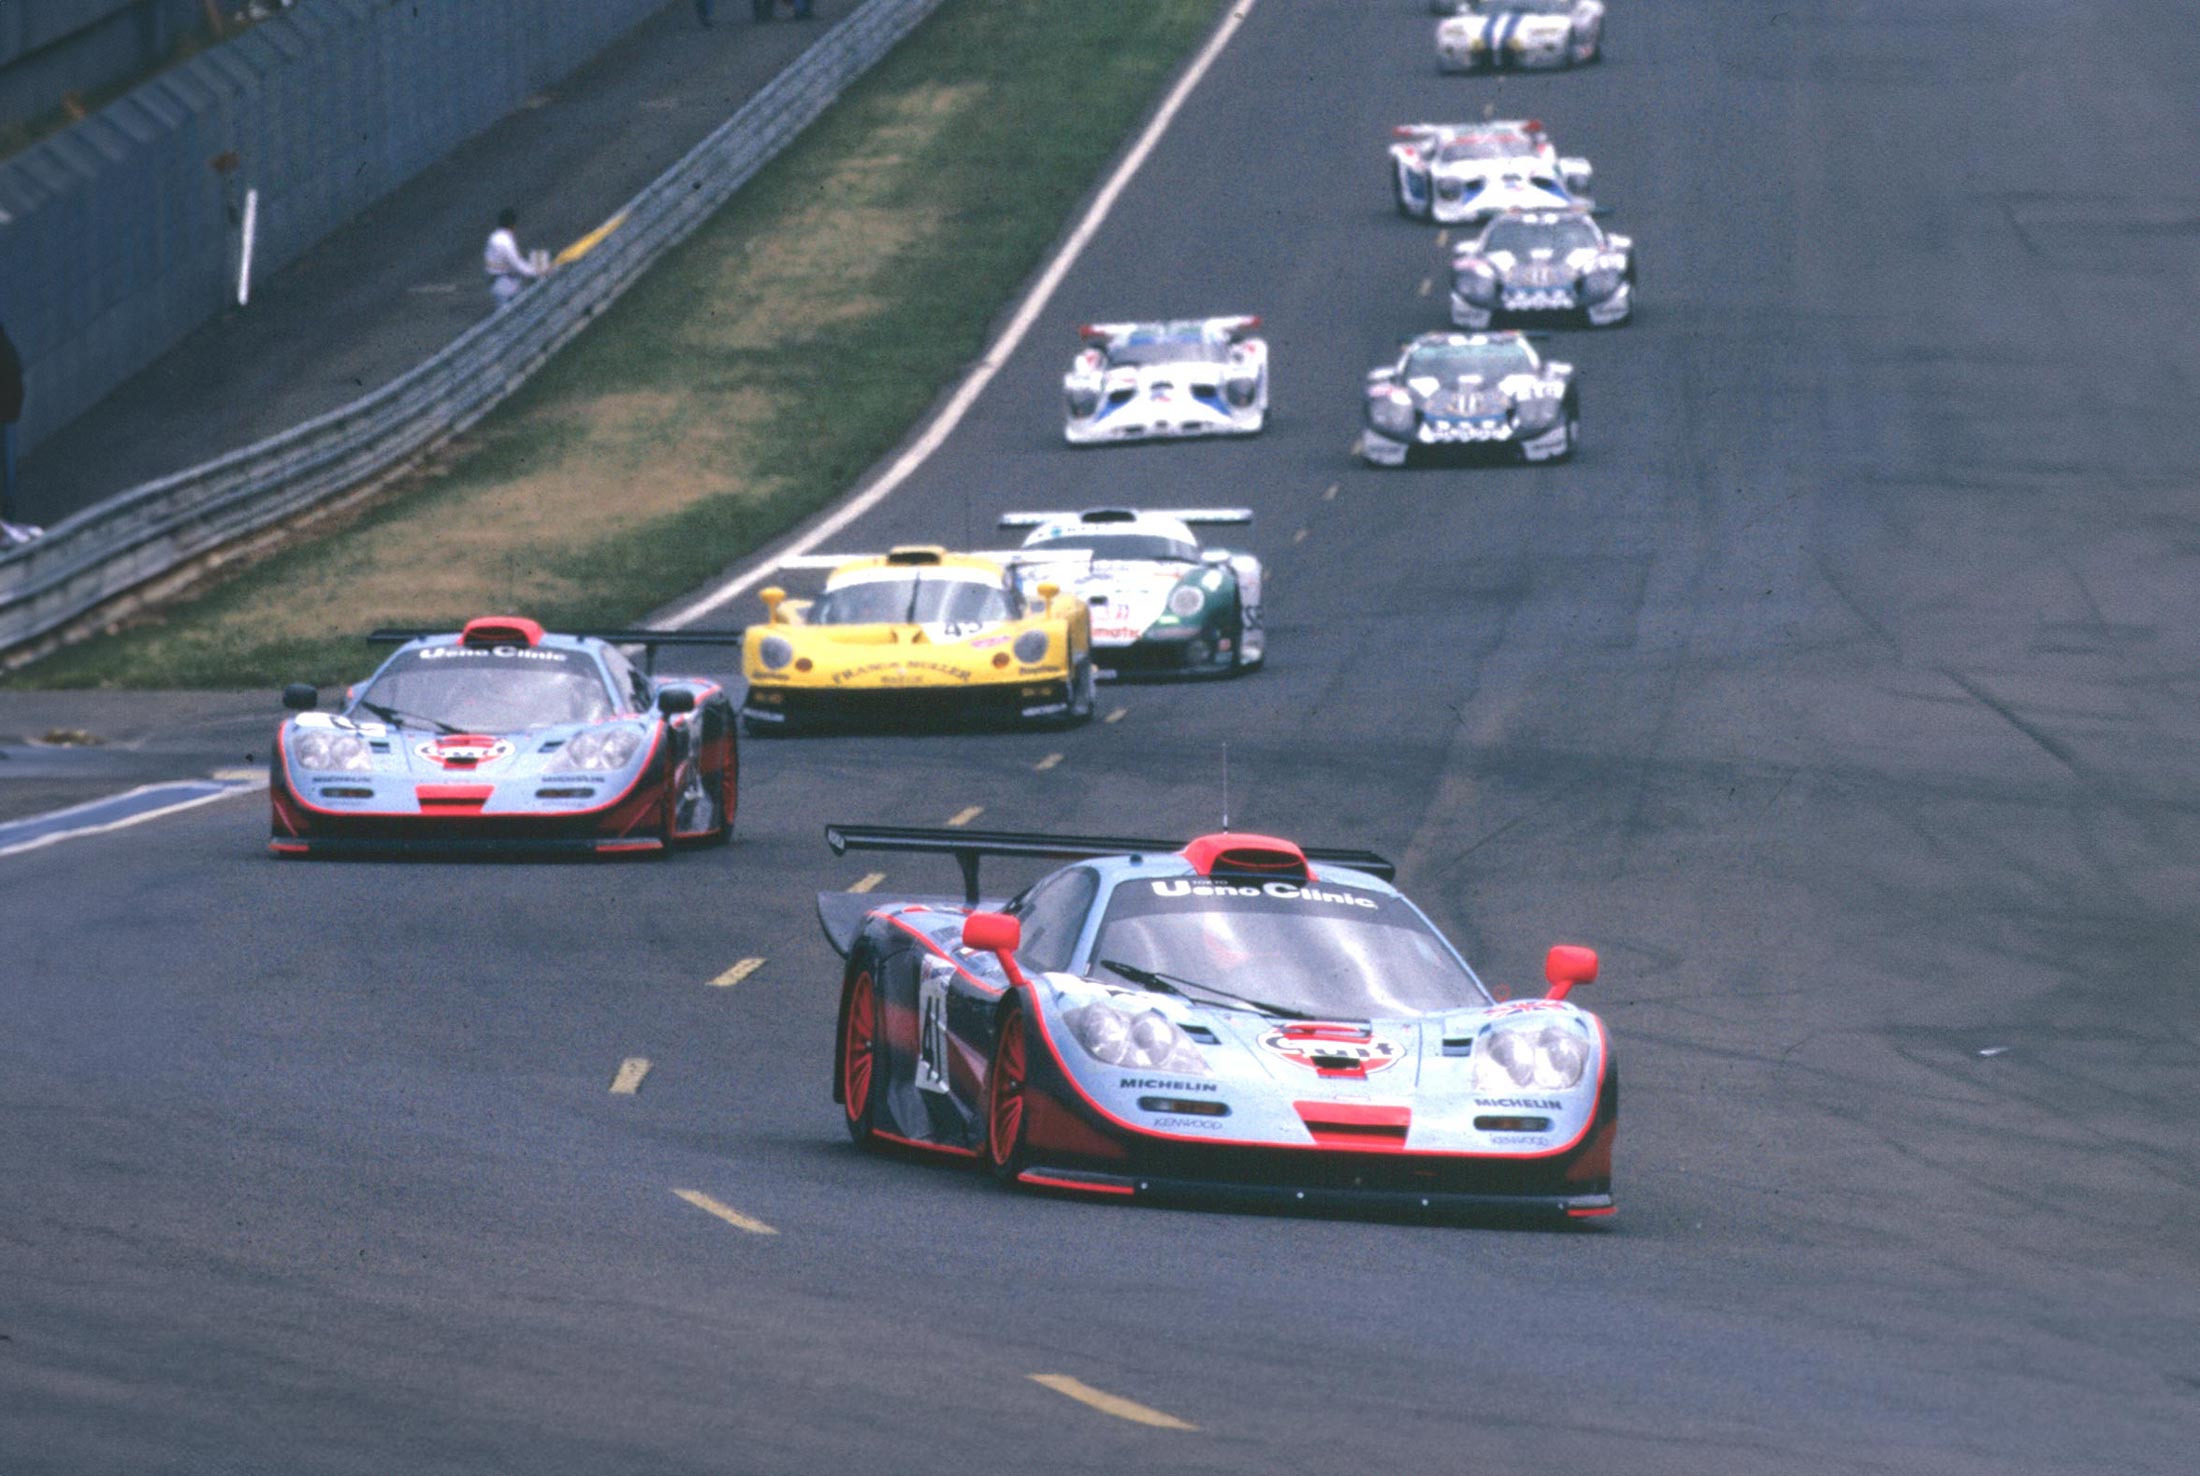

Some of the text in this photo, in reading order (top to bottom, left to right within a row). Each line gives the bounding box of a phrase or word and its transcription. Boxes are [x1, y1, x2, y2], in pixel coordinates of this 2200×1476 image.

[420, 646, 568, 662] Ueno Clinic
[1151, 879, 1379, 909] Ueno Clinic
[1119, 1078, 1218, 1092] MICHELIN
[1474, 1098, 1562, 1110] MICHELIN
